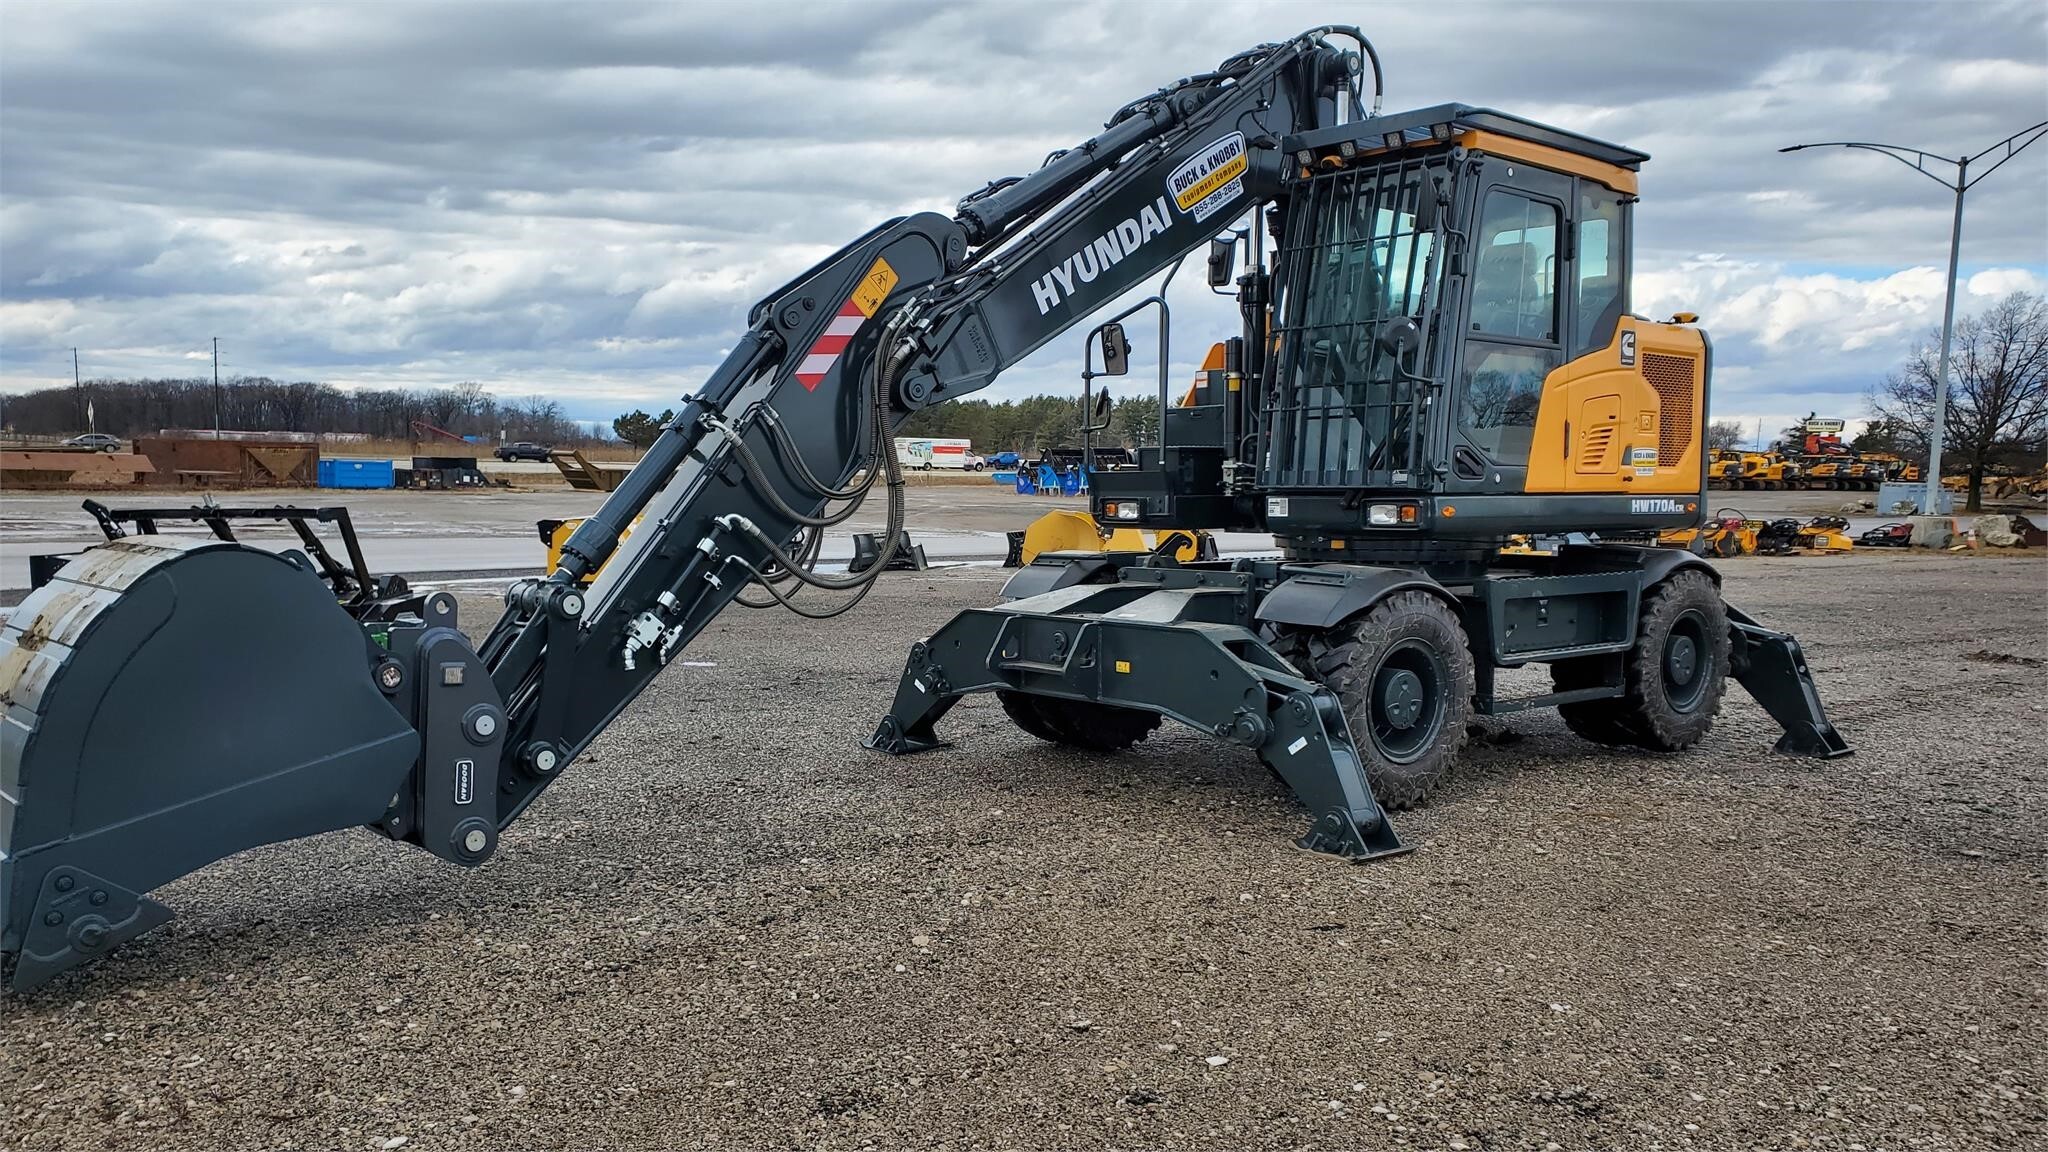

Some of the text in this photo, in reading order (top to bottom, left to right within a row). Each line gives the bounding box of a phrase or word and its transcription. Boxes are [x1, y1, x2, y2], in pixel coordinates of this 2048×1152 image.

[1173, 139, 1241, 193] BUCK & KNOBBY
[1183, 160, 1243, 204] Equipment Company
[1194, 179, 1242, 215] 855-288-2825
[1030, 195, 1173, 316] HYUNDAI
[460, 764, 468, 800] DOOSAN
